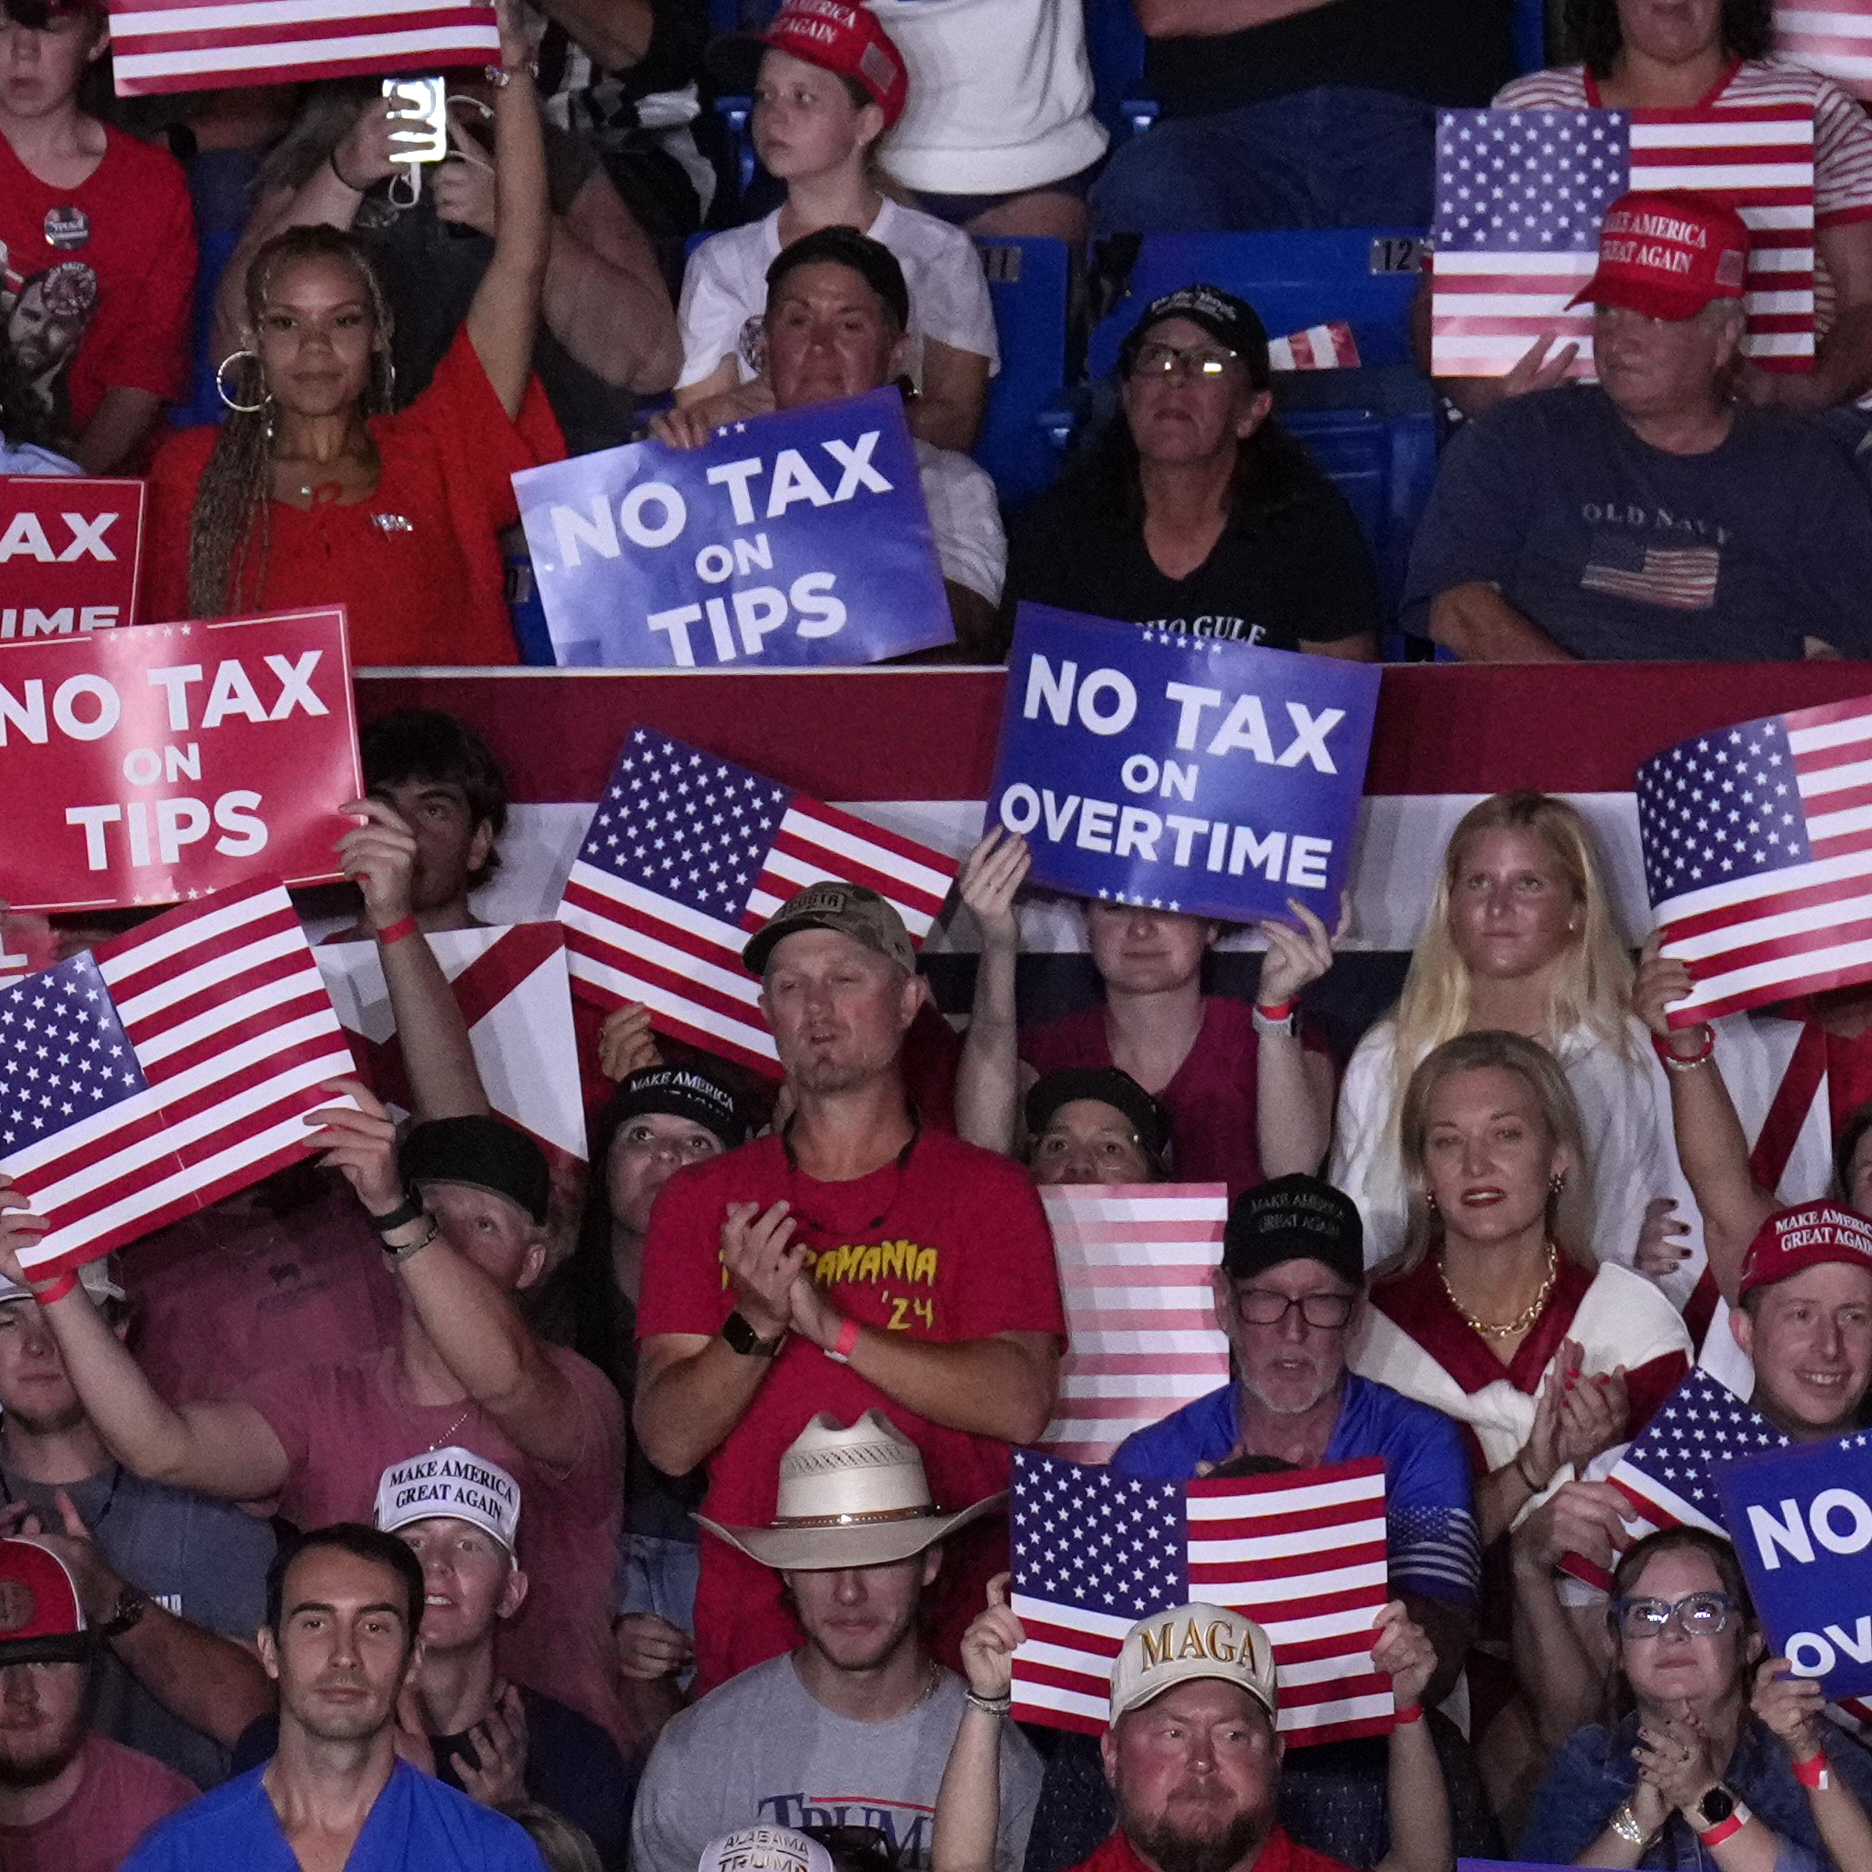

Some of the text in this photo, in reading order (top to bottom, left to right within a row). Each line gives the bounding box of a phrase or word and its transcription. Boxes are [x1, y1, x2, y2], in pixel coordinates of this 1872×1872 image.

[1382, 237, 1416, 271] 12
[1634, 221, 1709, 252] AMERICA
[1638, 245, 1694, 275] AGAIN
[548, 430, 894, 568] NO TAX
[1582, 501, 1647, 526] OLD
[695, 534, 772, 585] ON
[647, 571, 847, 666] TIPS
[1194, 616, 1266, 647] GULF
[147, 649, 330, 732] TAX
[1023, 652, 1347, 775] NO TAX
[122, 742, 202, 786] ON
[1120, 752, 1198, 801] ON
[65, 791, 268, 871] TIPS
[999, 782, 1333, 890] OVERTIME
[629, 1071, 735, 1112] MAKE AMERICA
[1775, 1212, 1816, 1234] MAKE
[1780, 1227, 1835, 1252] GREAT
[388, 1456, 514, 1505] MAKE AMERICA
[395, 1480, 504, 1521] GREAT AGAIN
[1746, 1488, 1872, 1570] NO
[1138, 1615, 1257, 1677] MAGA
